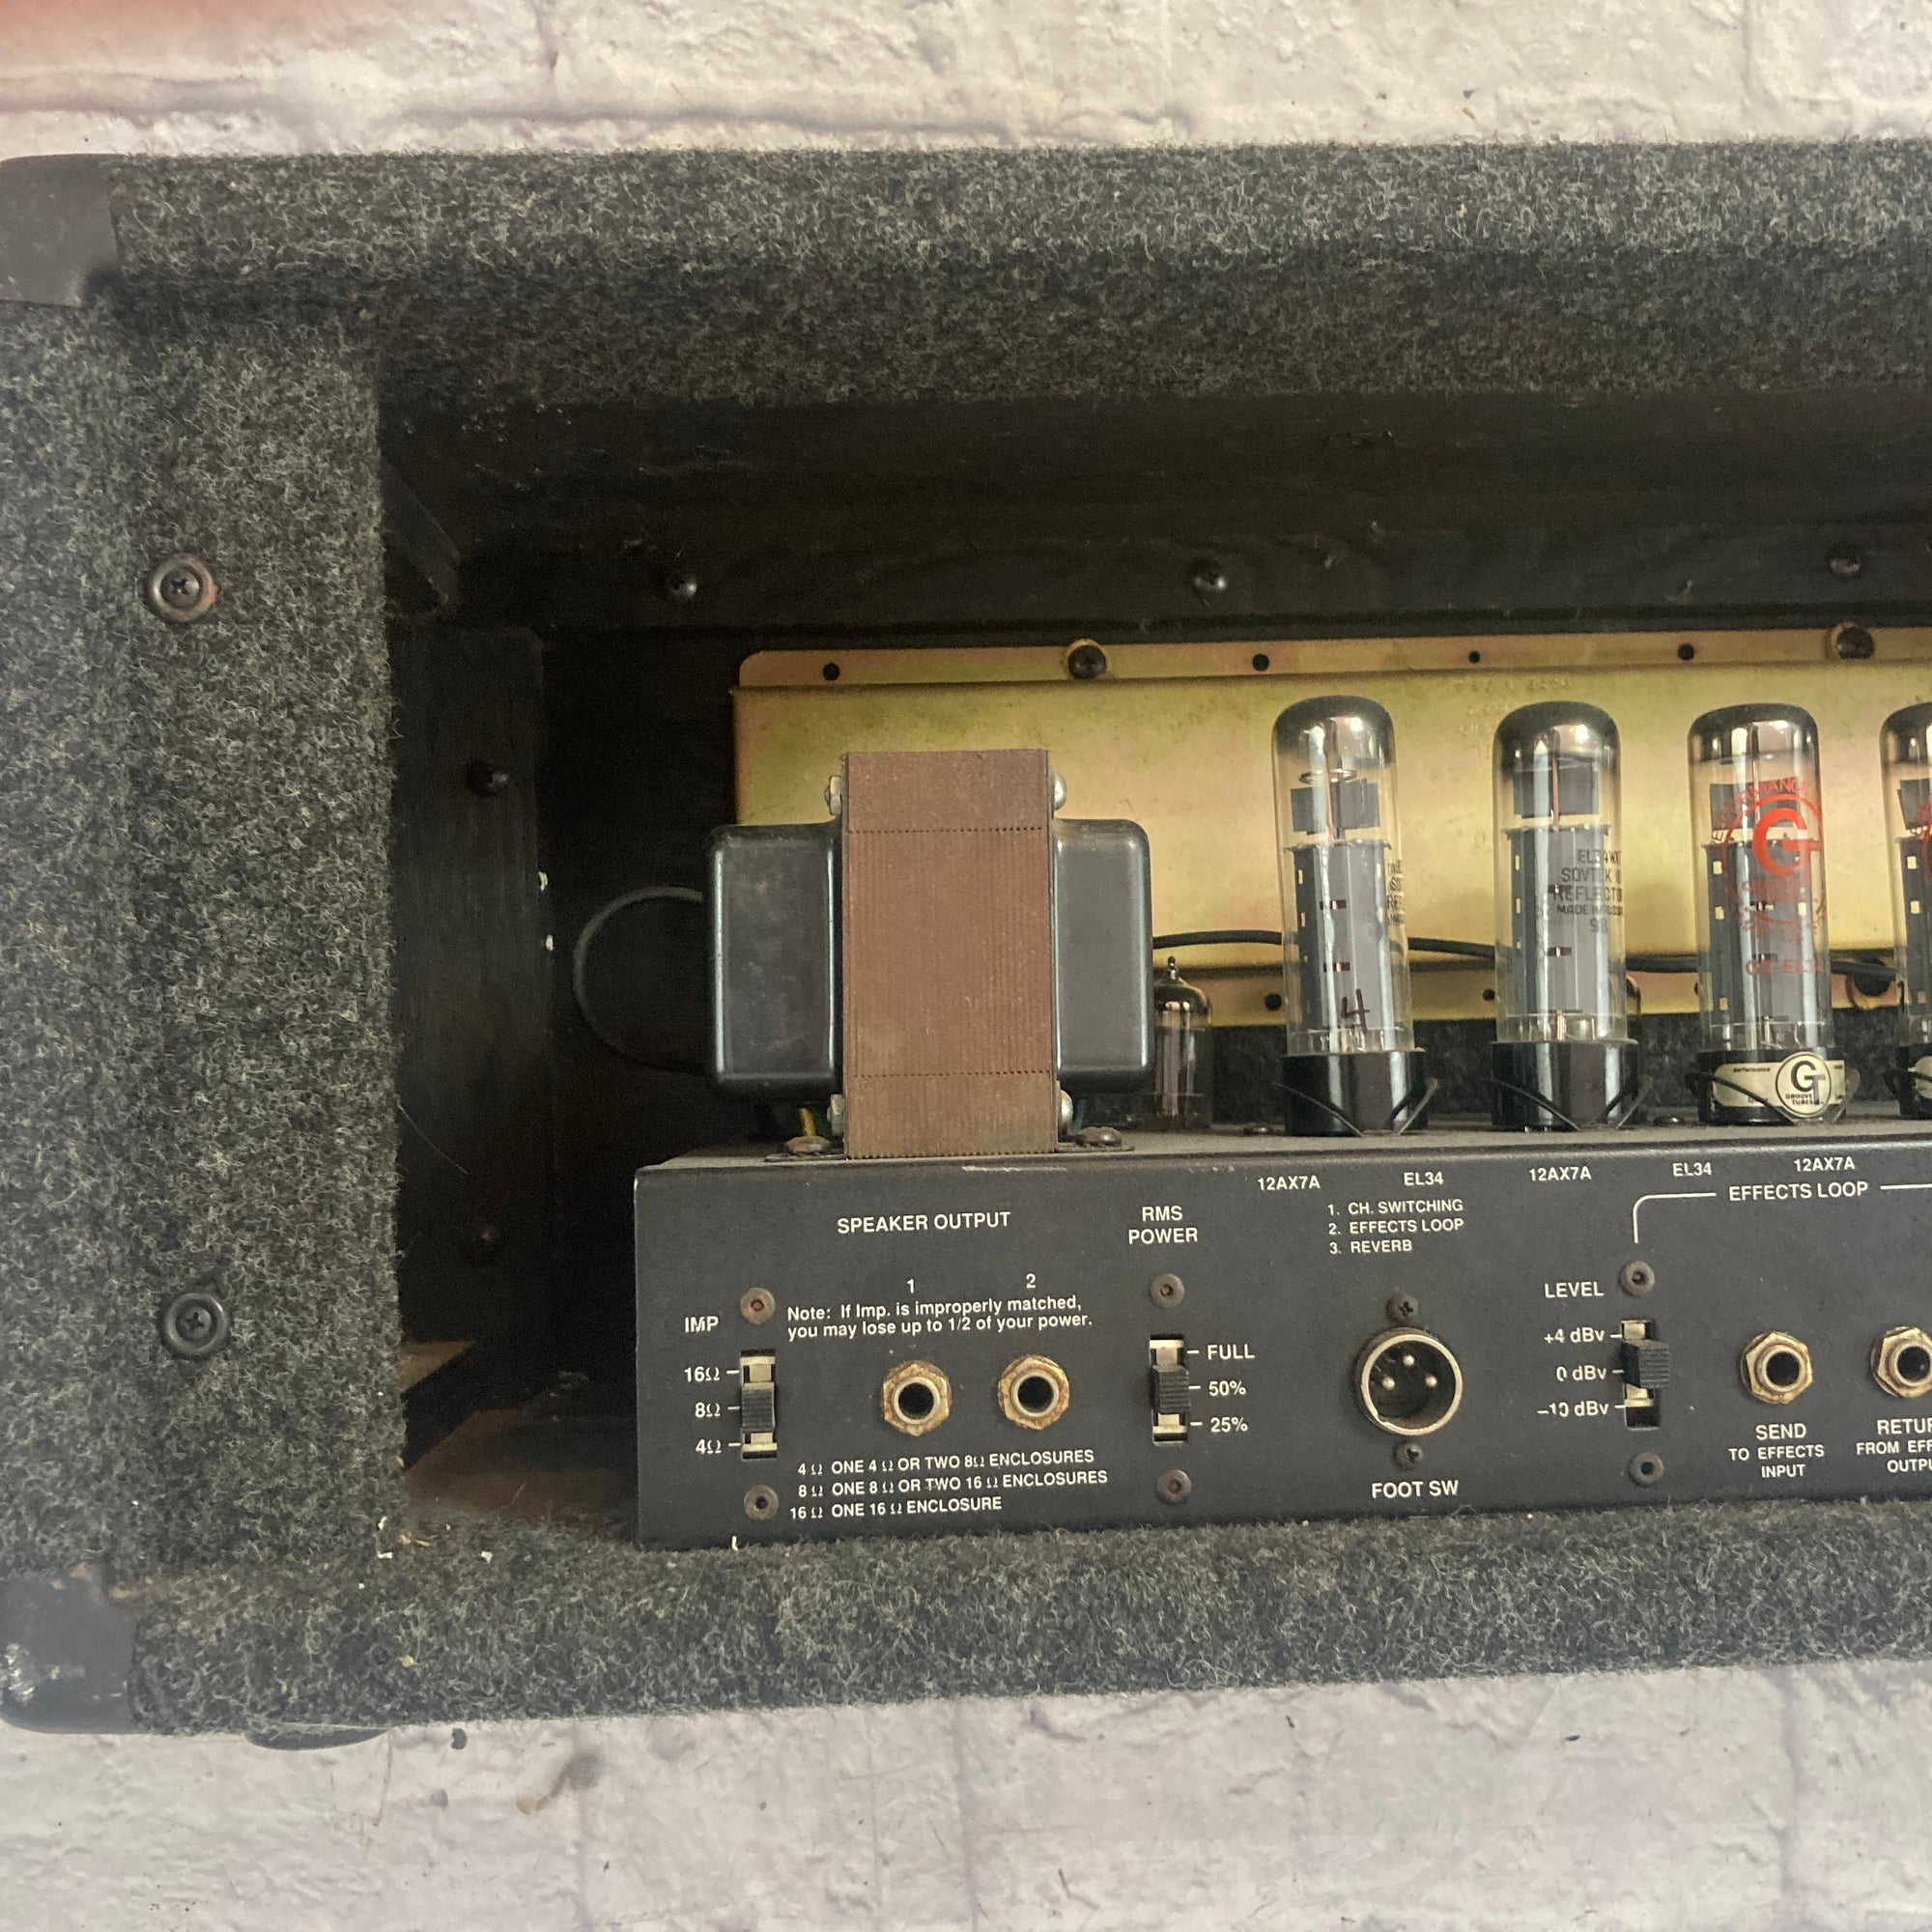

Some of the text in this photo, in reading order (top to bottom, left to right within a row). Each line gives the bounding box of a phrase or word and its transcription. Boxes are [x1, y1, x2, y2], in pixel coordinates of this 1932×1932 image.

[1341, 988, 1371, 1034] 4
[1673, 1162, 1712, 1176] EL34
[1795, 1156, 1855, 1171] 12AX7A
[1405, 1172, 1443, 1185] EL34
[1530, 1166, 1591, 1180] 12AX7A
[1258, 1176, 1320, 1190] 12AX7A
[1729, 1181, 1867, 1201] EFFECTS LOOP
[1143, 1206, 1182, 1221] RMS
[1328, 1199, 1463, 1215] 1. CH. SWITCHING
[838, 1211, 1010, 1234] SPEAKER OUTPUT
[1329, 1218, 1463, 1235] 2. EFFECTS LOOP
[1129, 1228, 1197, 1244] POWER
[1330, 1239, 1411, 1254] 3. REVERB
[907, 1279, 914, 1293] 1
[1026, 1273, 1036, 1288] 2
[1545, 1282, 1604, 1297] LEVEL
[788, 1295, 1081, 1321] Note: If Imp. is improperly matched,
[686, 1317, 718, 1332] IMP
[788, 1316, 1092, 1342] you may lose up to 1/2 of your power.
[1545, 1327, 1605, 1343] +4 dBv
[1208, 1344, 1255, 1360] FULL
[685, 1367, 720, 1381] 16Ω
[1557, 1365, 1605, 1381] 0 dBv
[1209, 1380, 1246, 1396] 50%
[696, 1403, 720, 1417] 8Ω
[1575, 1401, 1608, 1416] dBv
[1211, 1417, 1248, 1432] 25%
[1756, 1424, 1805, 1440] SEND
[696, 1439, 721, 1454] 4Ω
[1729, 1444, 1824, 1461] TO EFFECTS
[1857, 1441, 1899, 1455] FROM
[798, 1463, 806, 1475] 4
[832, 1460, 864, 1474] ONE
[869, 1460, 876, 1471] 4
[898, 1458, 920, 1470] OR
[924, 1456, 959, 1469] TWO
[990, 1450, 1094, 1466] ENCLOSURES
[1762, 1464, 1805, 1477] INPUT
[799, 1485, 807, 1497] 8
[833, 1482, 865, 1495] ONE
[869, 1481, 877, 1493] 8
[898, 1479, 921, 1492] OR
[925, 1477, 960, 1491] TWO
[966, 1476, 981, 1489] 16
[1004, 1470, 1107, 1487] ENCLOSURES
[1373, 1480, 1458, 1498] FOOT SW
[790, 1507, 806, 1519] 16
[832, 1503, 865, 1517] ONE
[870, 1502, 885, 1515] 16
[907, 1496, 1002, 1514] ENCLOSURE
